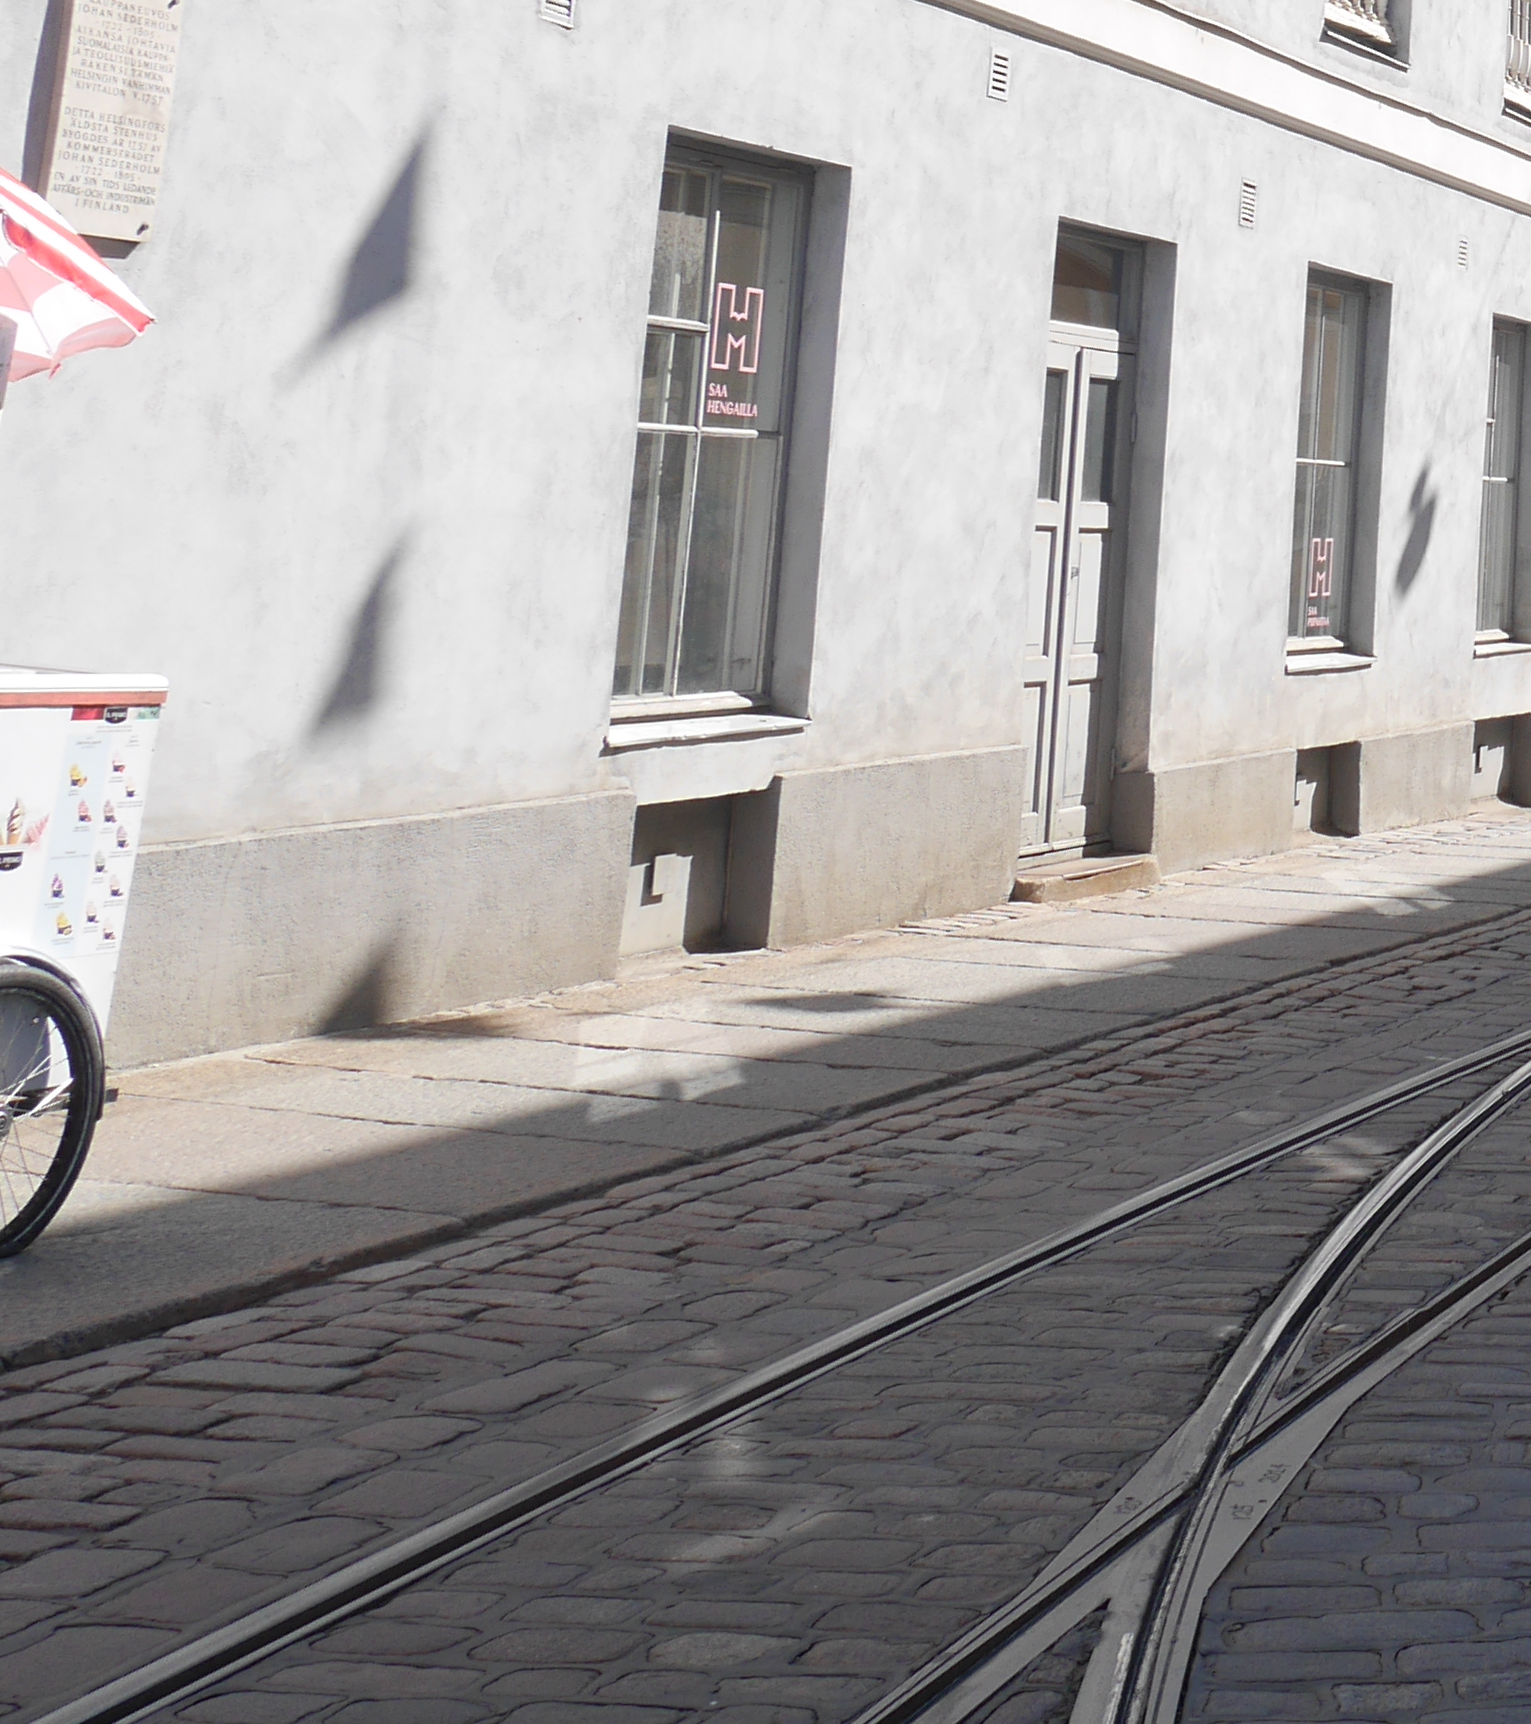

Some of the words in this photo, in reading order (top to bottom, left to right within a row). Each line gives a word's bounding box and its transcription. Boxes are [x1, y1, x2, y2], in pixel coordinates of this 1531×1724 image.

[78, 3, 113, 18] JOHAN
[117, 13, 179, 32] SEDERHOLM
[127, 35, 176, 54] JOHTAVIA
[71, 67, 118, 84] HELSINGIN
[64, 105, 95, 120] DETTA
[99, 112, 166, 133] HELSINGFORS
[61, 128, 108, 144] BYGGDES
[113, 125, 158, 142] STENHUS
[57, 150, 94, 164] JOHAN
[98, 157, 161, 174] SEDERHOLM
[53, 171, 65, 181] EN
[69, 174, 81, 183] AV
[83, 176, 97, 186] SIN
[102, 179, 120, 190] TIDS
[123, 182, 157, 196] LEDANDE
[82, 198, 130, 214] FINLAND
[708, 382, 728, 398] SAA
[706, 400, 758, 418] HENGAILLA
